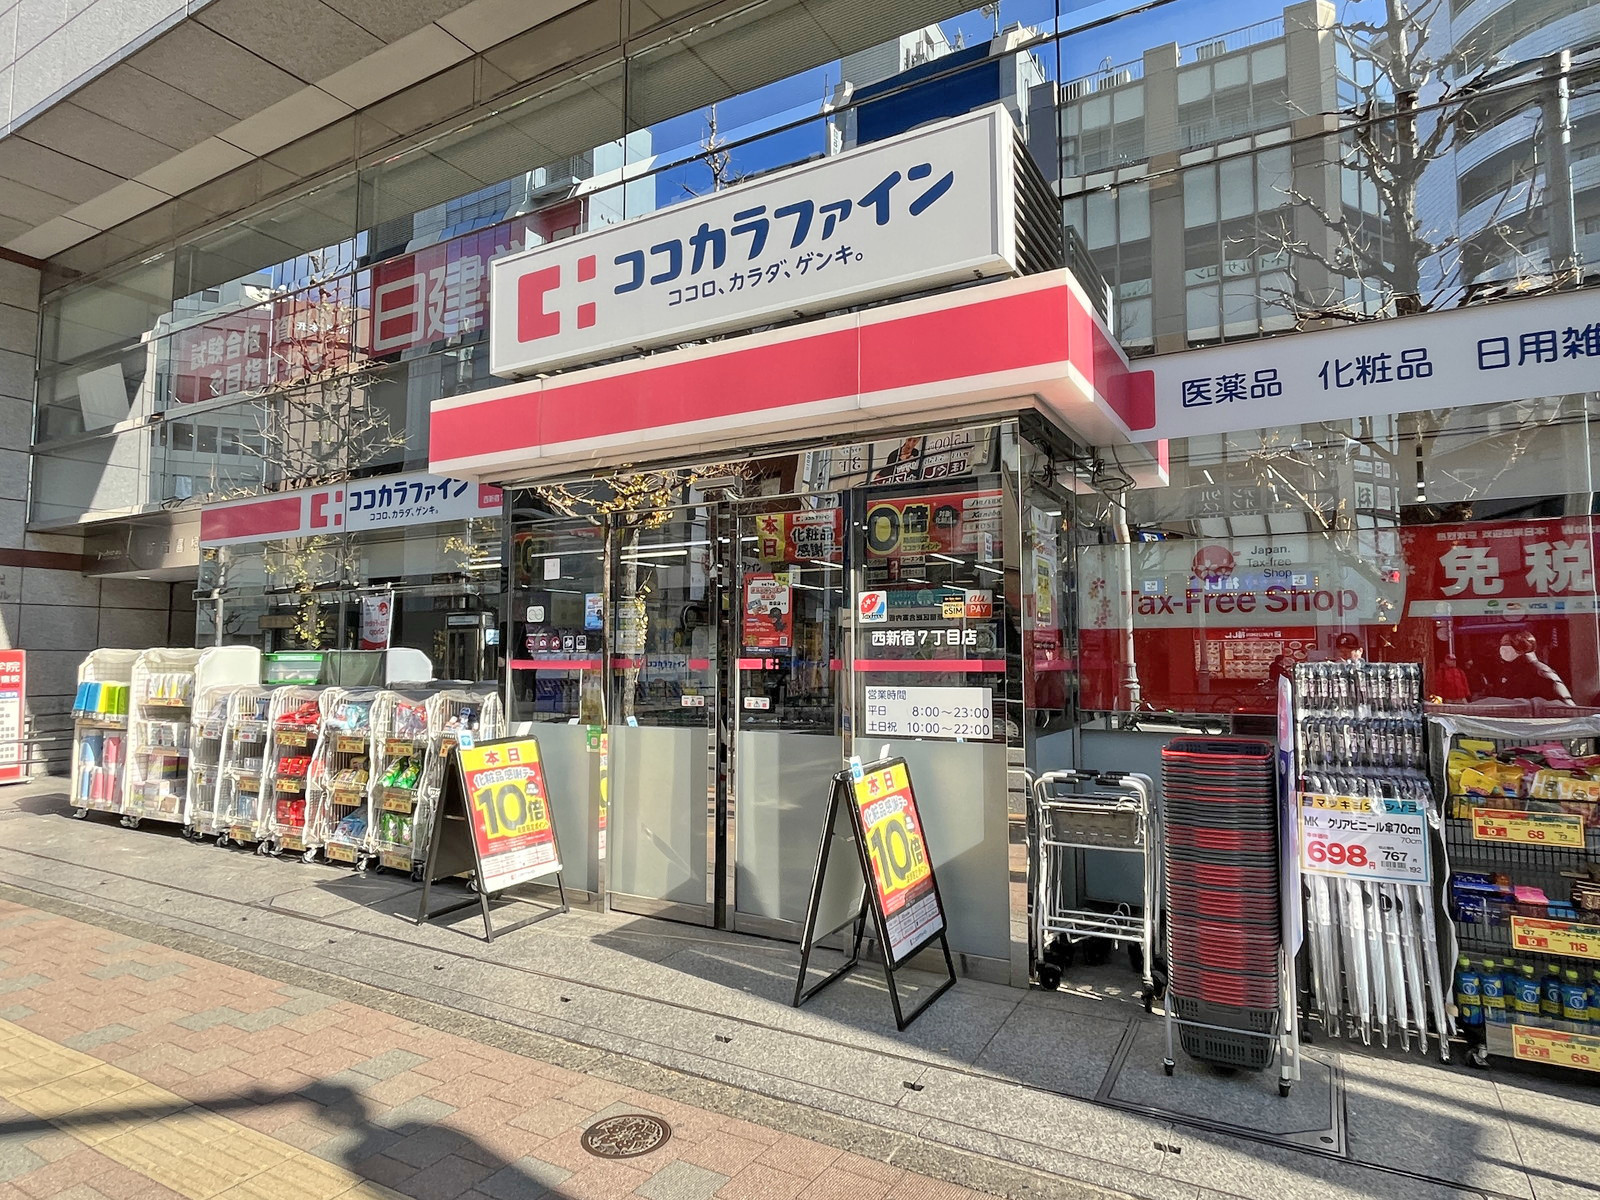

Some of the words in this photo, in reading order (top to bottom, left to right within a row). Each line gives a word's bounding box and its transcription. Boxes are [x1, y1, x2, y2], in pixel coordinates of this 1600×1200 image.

[613, 162, 954, 296] ココカラファイン
[668, 245, 863, 307] ココロ、カラダ、ゲンキ。
[1181, 368, 1283, 408] 医薬品
[1317, 346, 1434, 391] 化粧品
[1476, 322, 1600, 371] 日用雑
[349, 477, 469, 512] ココカラファイン
[369, 505, 439, 522] ココロ、カラダ、ゲンキ。
[761, 515, 779, 558] 本日
[791, 526, 835, 543] 化粧品
[796, 542, 843, 558] 感謝デー
[1246, 557, 1292, 569] Tax-free
[1439, 539, 1594, 597] 免税
[1262, 568, 1293, 580] Shop
[970, 605, 988, 613] PAY
[1121, 588, 1256, 616] Tax-Free
[1264, 585, 1359, 618] Shop
[943, 607, 963, 615] eSIM
[871, 629, 978, 647] 西新宿7丁目店
[867, 689, 907, 701] 営業時間
[867, 705, 887, 716] 平日
[867, 721, 898, 733] 土日祝
[484, 747, 521, 766] 本日
[473, 766, 535, 787] 化粧品感謝デー
[867, 770, 895, 796] 本日
[477, 783, 528, 835] 10
[527, 799, 545, 823] 倍
[1304, 815, 1319, 828] MK
[1327, 818, 1421, 836] クリアビニール傘70cm
[1486, 828, 1497, 836] 10
[1400, 836, 1423, 845] 70cm
[1527, 829, 1545, 840] 68
[870, 818, 912, 890] 10
[910, 836, 924, 868] 倍
[1307, 840, 1369, 868] 698
[1368, 861, 1377, 870] 円
[1381, 850, 1409, 862] 767
[1408, 866, 1422, 874] 192
[1526, 938, 1537, 947] 10
[1568, 941, 1589, 953] 118
[1570, 1053, 1590, 1065] 68
